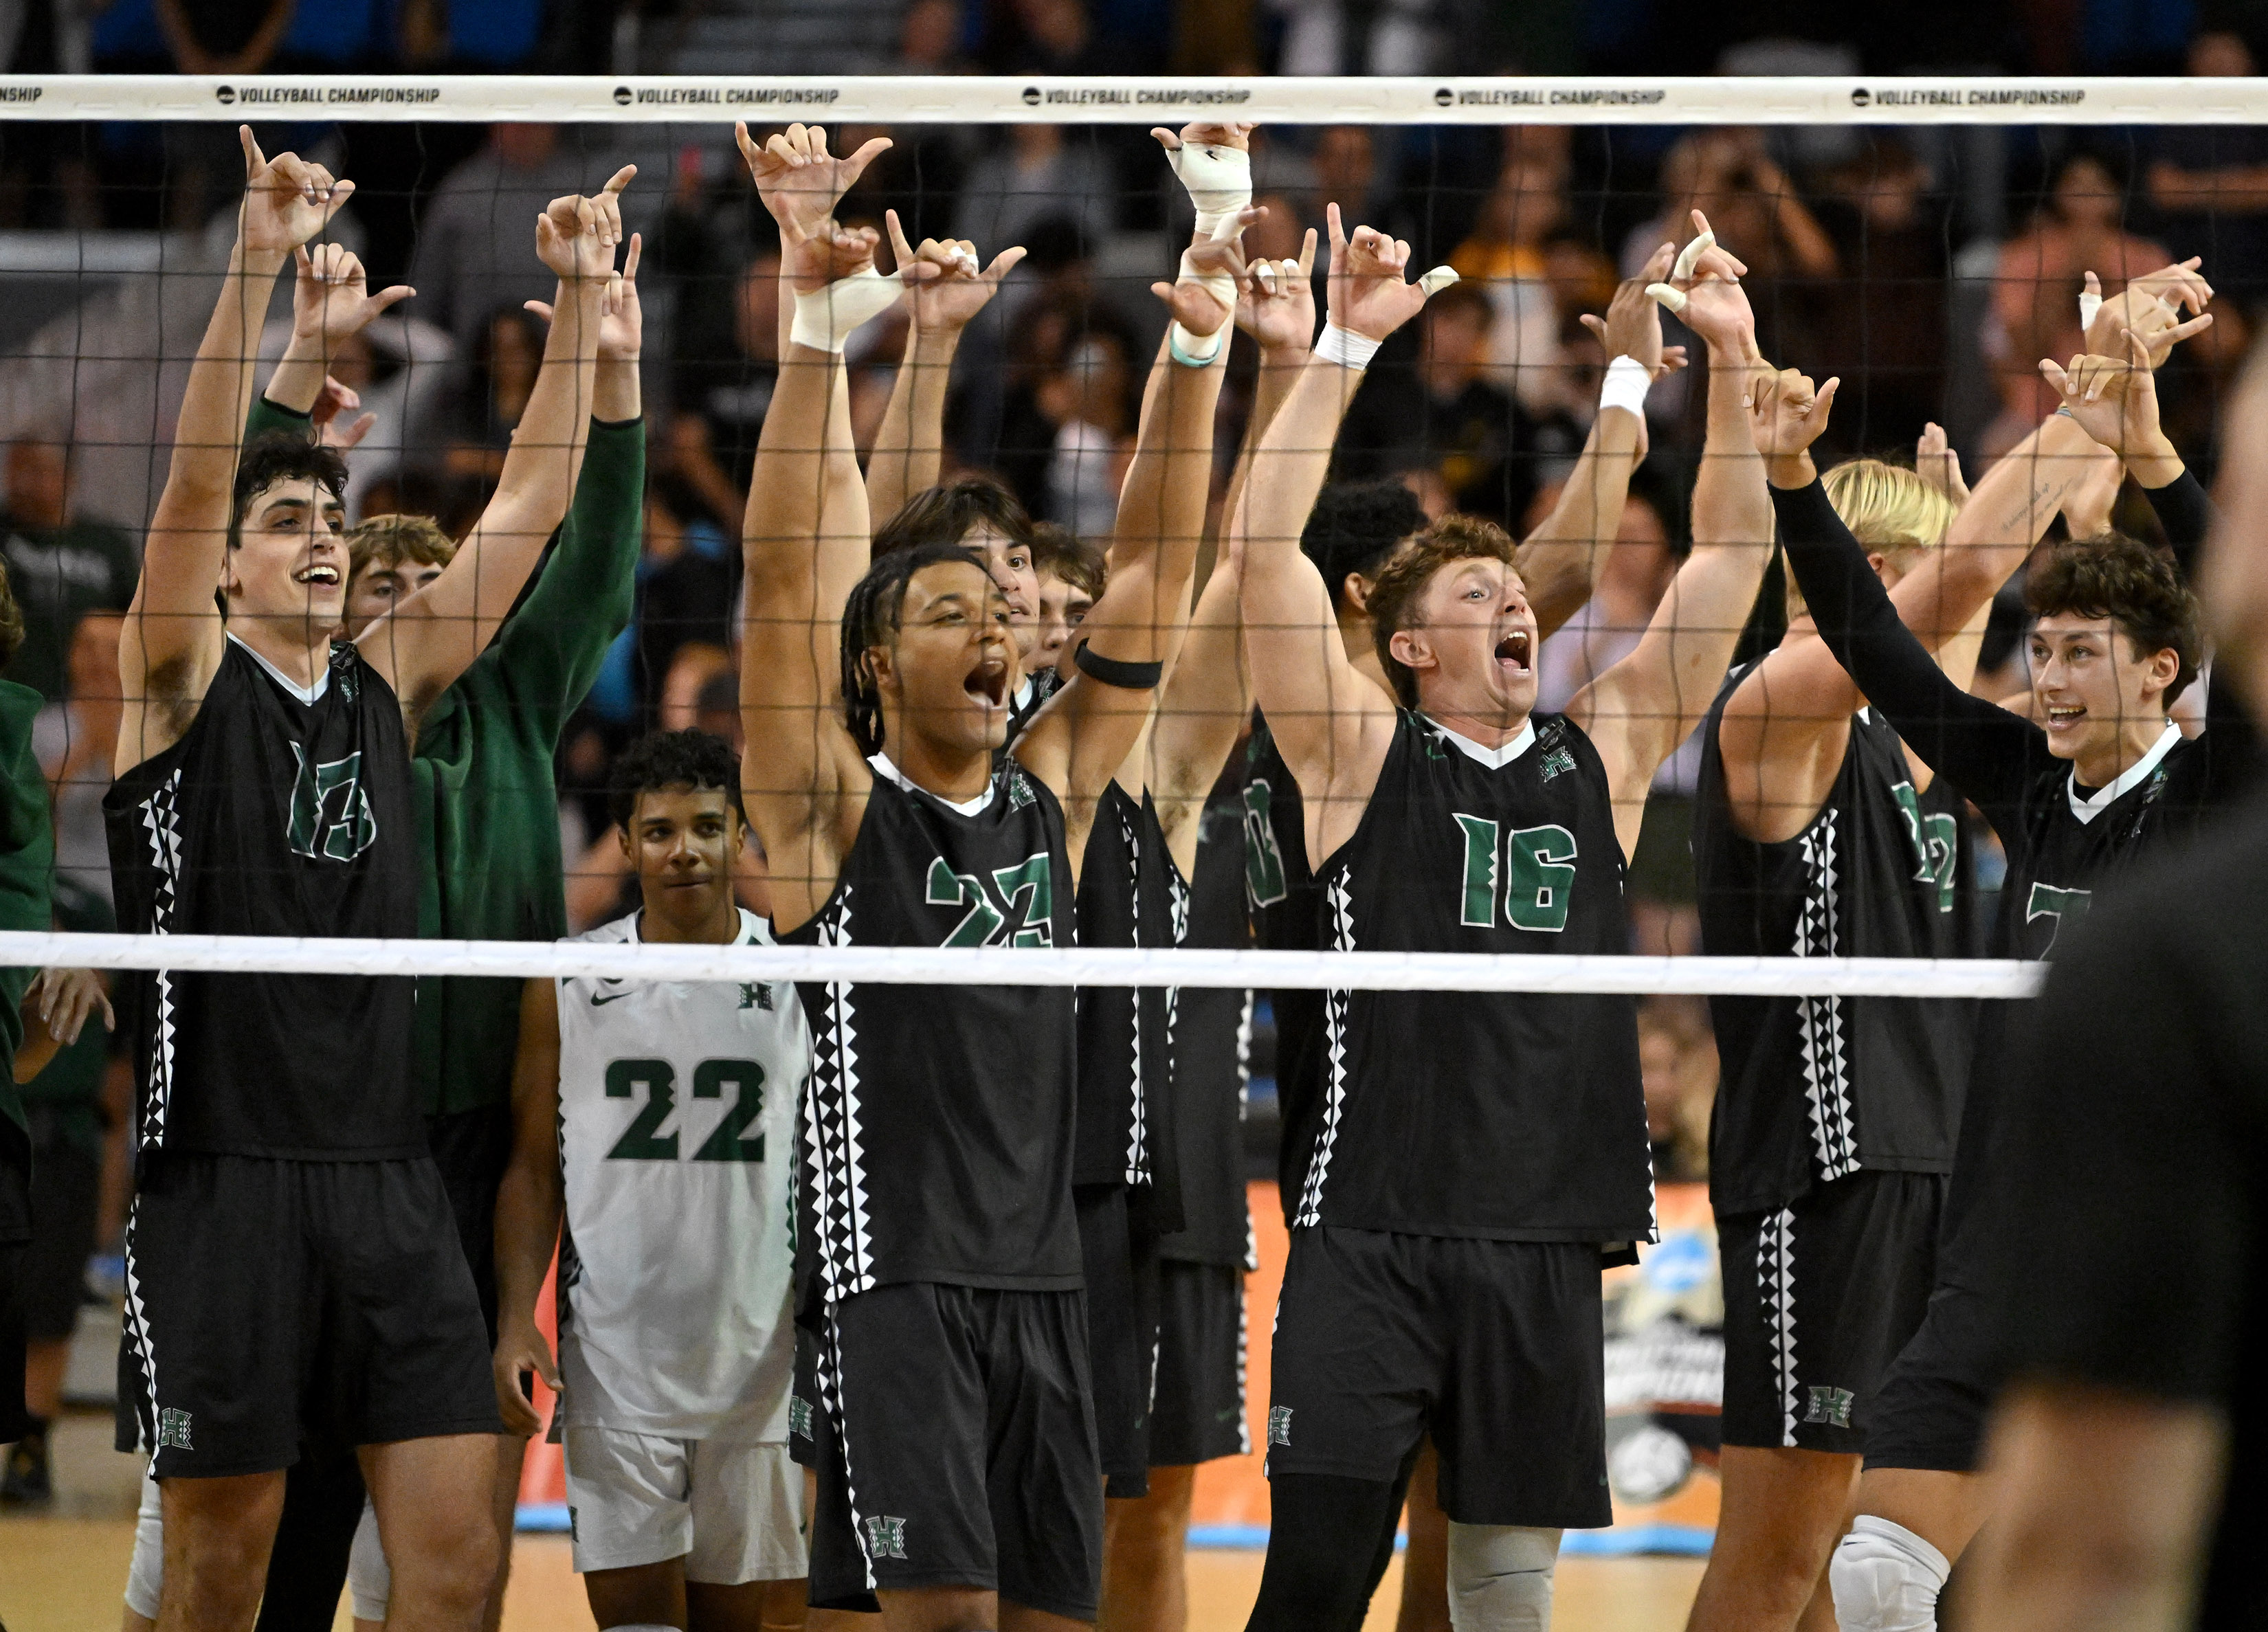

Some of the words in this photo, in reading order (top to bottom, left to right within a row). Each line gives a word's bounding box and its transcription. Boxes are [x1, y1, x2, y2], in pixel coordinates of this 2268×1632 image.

[239, 88, 323, 103] VOLLEYBALL
[327, 88, 440, 103] CHAMPIONSHIP
[636, 89, 721, 104] VOLLEYBALL
[725, 89, 839, 104] CHAMPIONSHIP
[1045, 90, 1131, 104] VOLLEYBALL
[1136, 90, 1250, 104] CHAMPIONSHIP
[1458, 91, 1544, 105] VOLLEYBALL
[1550, 91, 1665, 105] CHAMPIONSHIP
[1875, 91, 1962, 105] VOLLEYBALL
[1967, 91, 2085, 105] CHAMPIONSHIP
[1452, 812, 1578, 932] 16
[603, 1056, 768, 1162] 22
